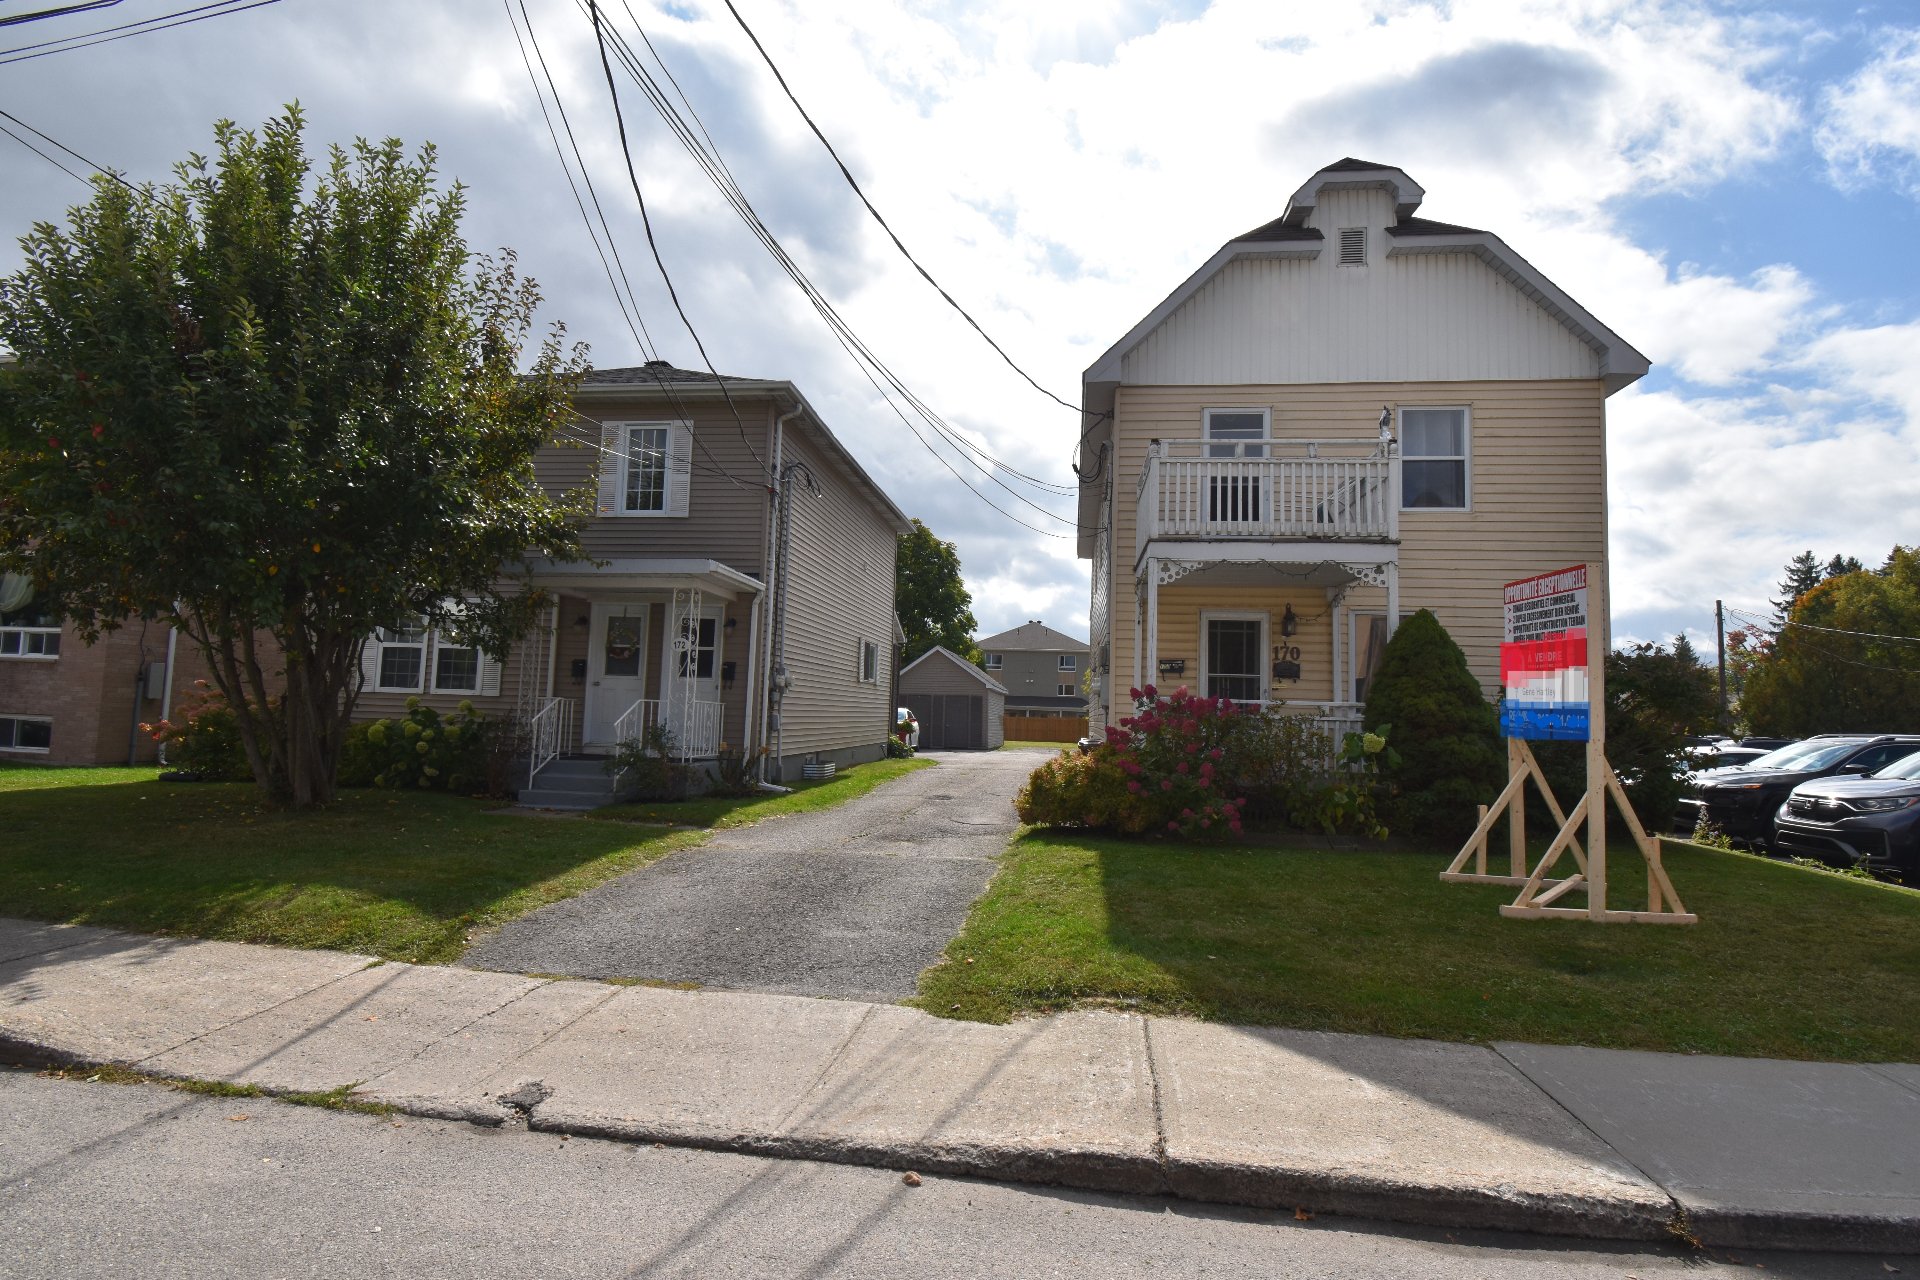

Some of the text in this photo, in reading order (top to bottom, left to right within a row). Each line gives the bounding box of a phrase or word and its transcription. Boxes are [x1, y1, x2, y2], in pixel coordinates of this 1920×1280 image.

[1505, 569, 1586, 603] OPPORTUNITÉ EXCEPTIONNELLE
[1545, 597, 1549, 607] ET
[1550, 592, 1576, 606] COMMERCIAL
[1554, 606, 1563, 617] BIEN
[1539, 617, 1568, 631] CONSTRUCTION
[1568, 614, 1586, 627] TERRAIN
[673, 641, 686, 649] 172
[1272, 645, 1301, 661] 170
[1535, 651, 1562, 662] VENDRE
